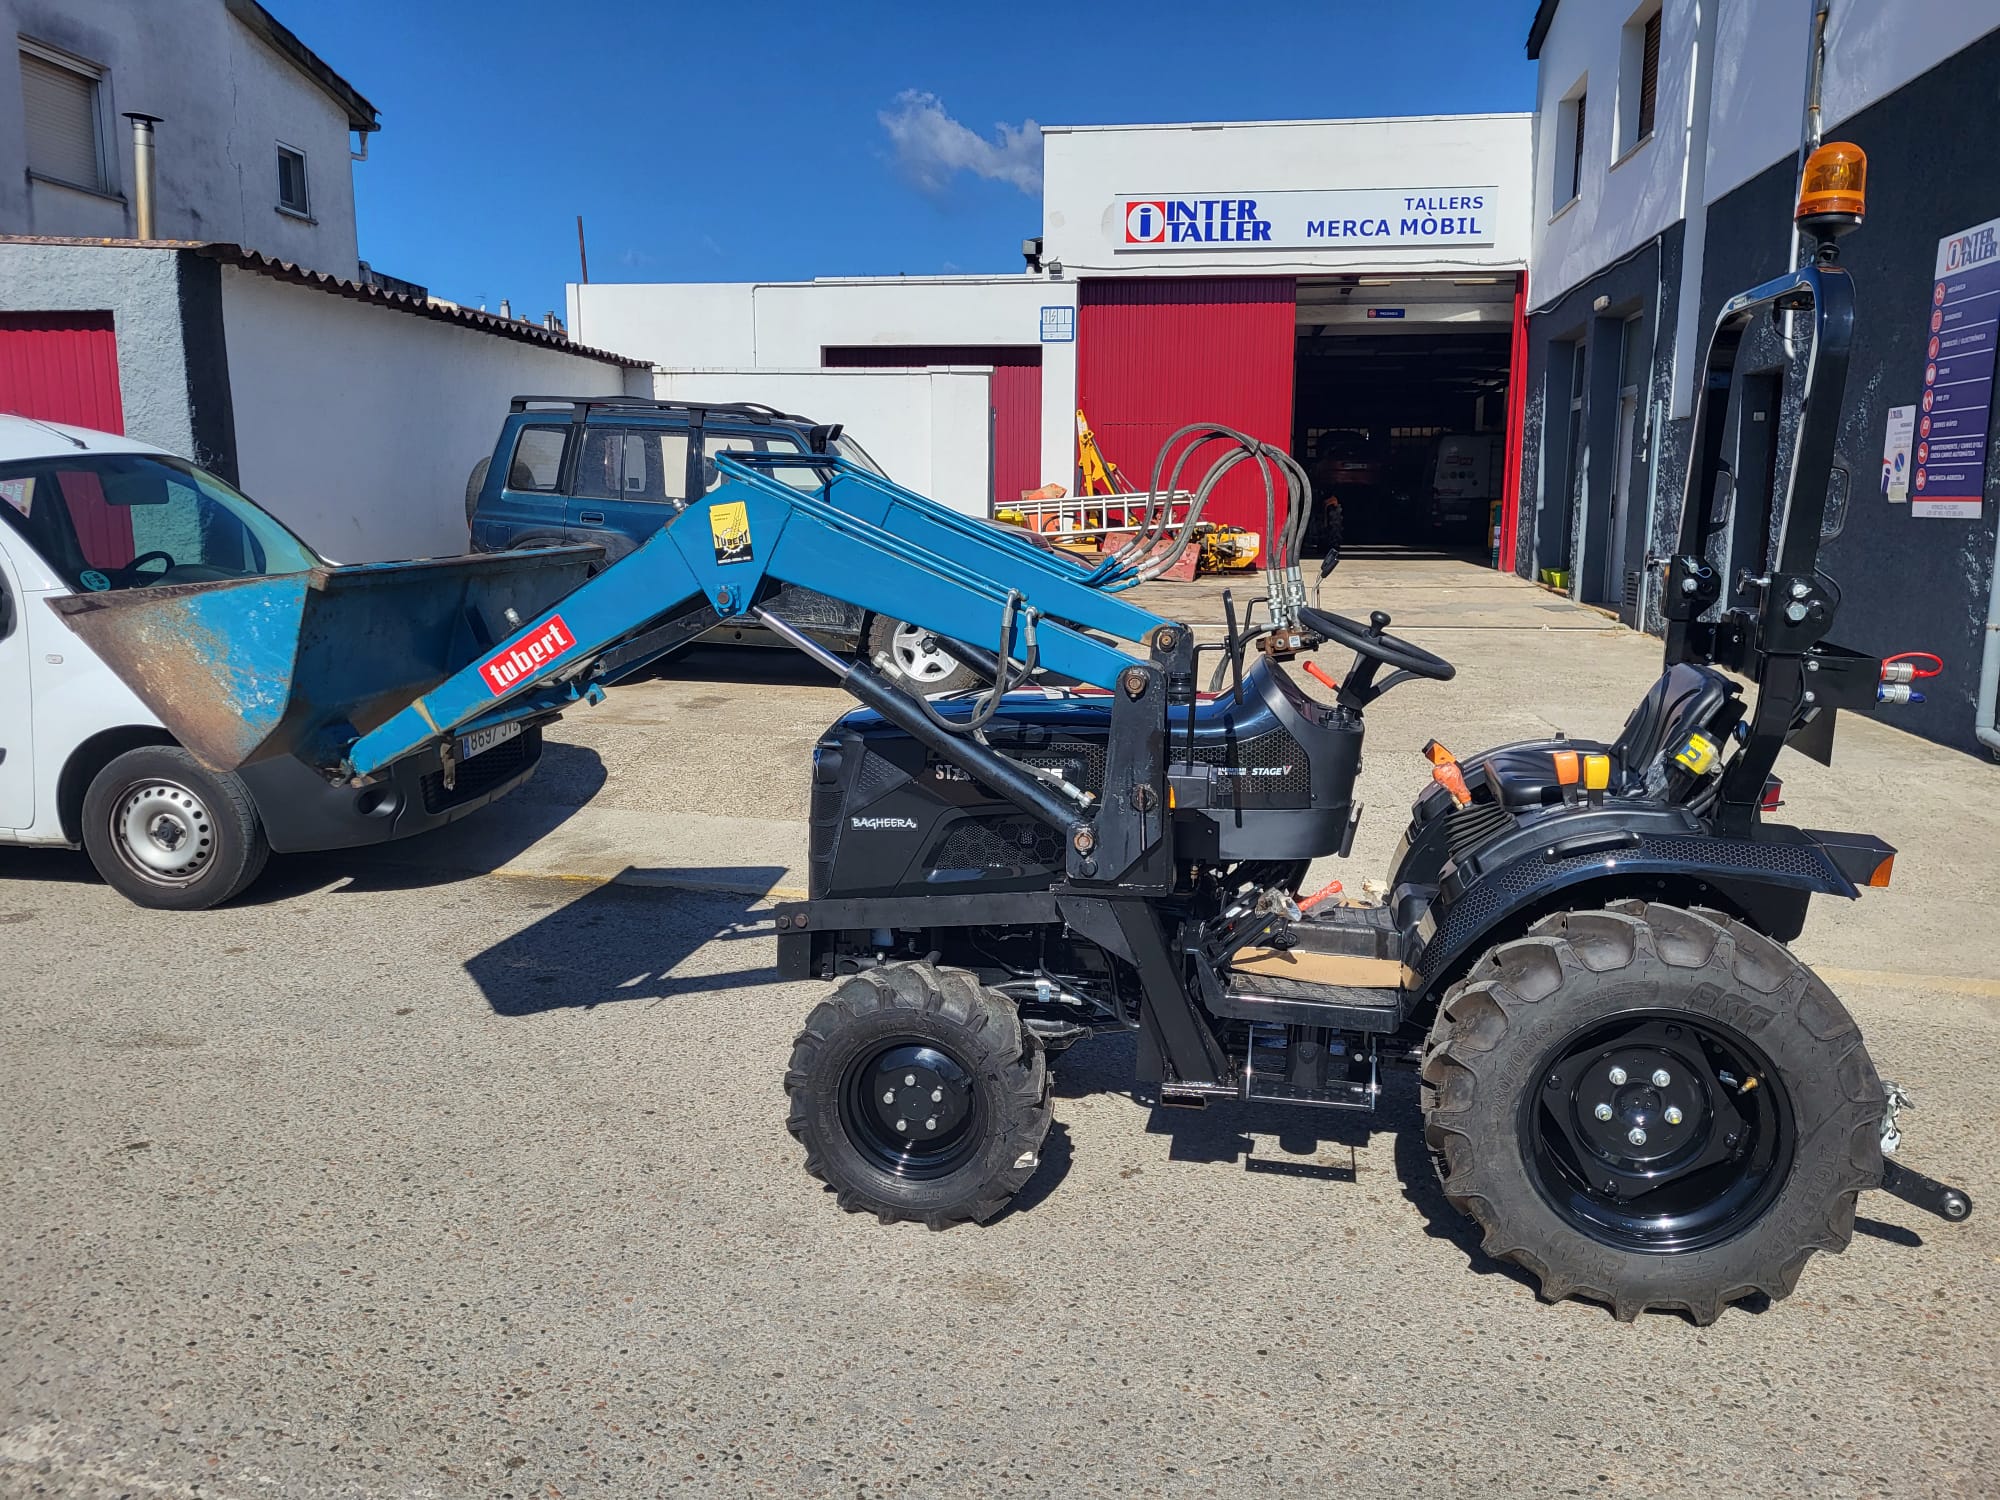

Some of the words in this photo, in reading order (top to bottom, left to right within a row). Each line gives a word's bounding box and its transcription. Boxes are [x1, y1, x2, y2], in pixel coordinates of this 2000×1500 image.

[1166, 199, 1257, 221] INTER
[1404, 196, 1484, 211] TALLERS
[1166, 221, 1272, 242] TALLER
[1306, 219, 1391, 237] MERCA
[1400, 212, 1482, 236] MÒBIL
[1962, 227, 1994, 251] INTER
[1960, 241, 1998, 267] TALLER
[714, 529, 749, 547] TUBERT
[489, 623, 568, 687] tubert
[851, 817, 914, 830] BAGHEERA
